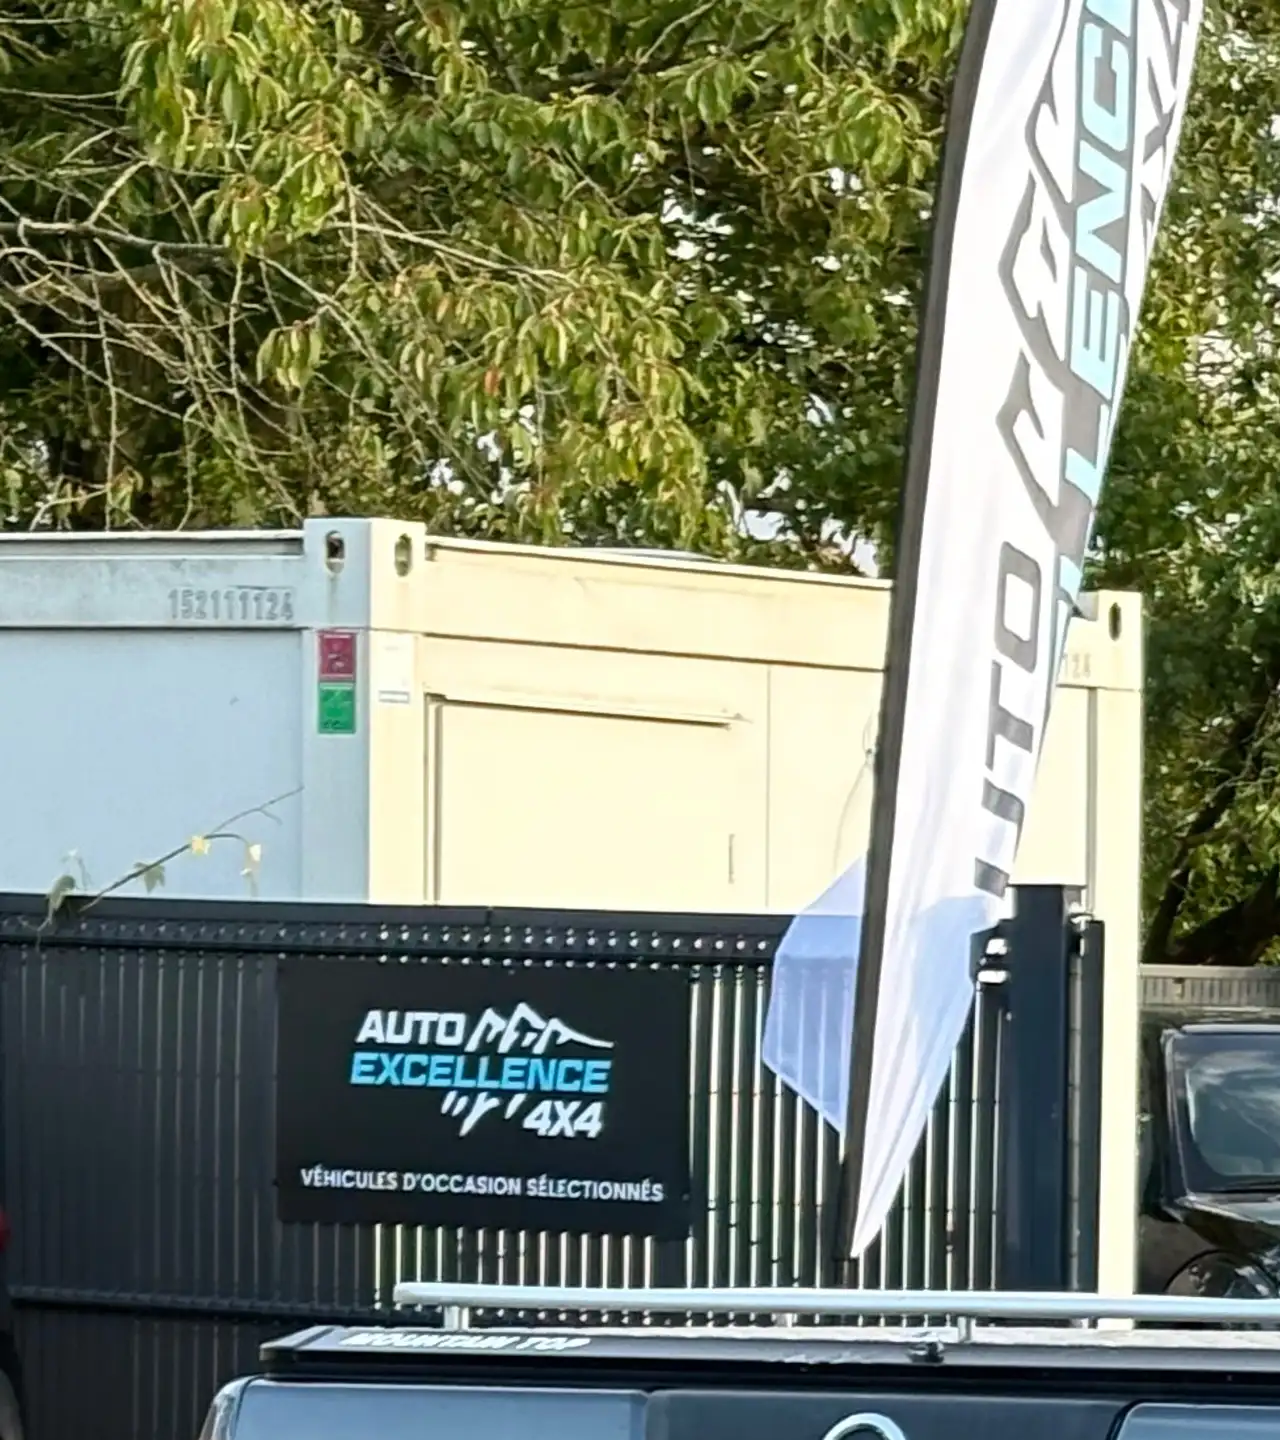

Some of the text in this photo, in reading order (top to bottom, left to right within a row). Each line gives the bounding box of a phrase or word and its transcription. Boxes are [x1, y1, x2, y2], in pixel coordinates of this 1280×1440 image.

[355, 1009, 467, 1045] AUTO
[350, 1051, 612, 1094] EXCELLENCE
[522, 1100, 604, 1139] 4X4
[300, 1163, 664, 1203] VÉHICULES D'OCCASION SÉLECTIONNÉS
